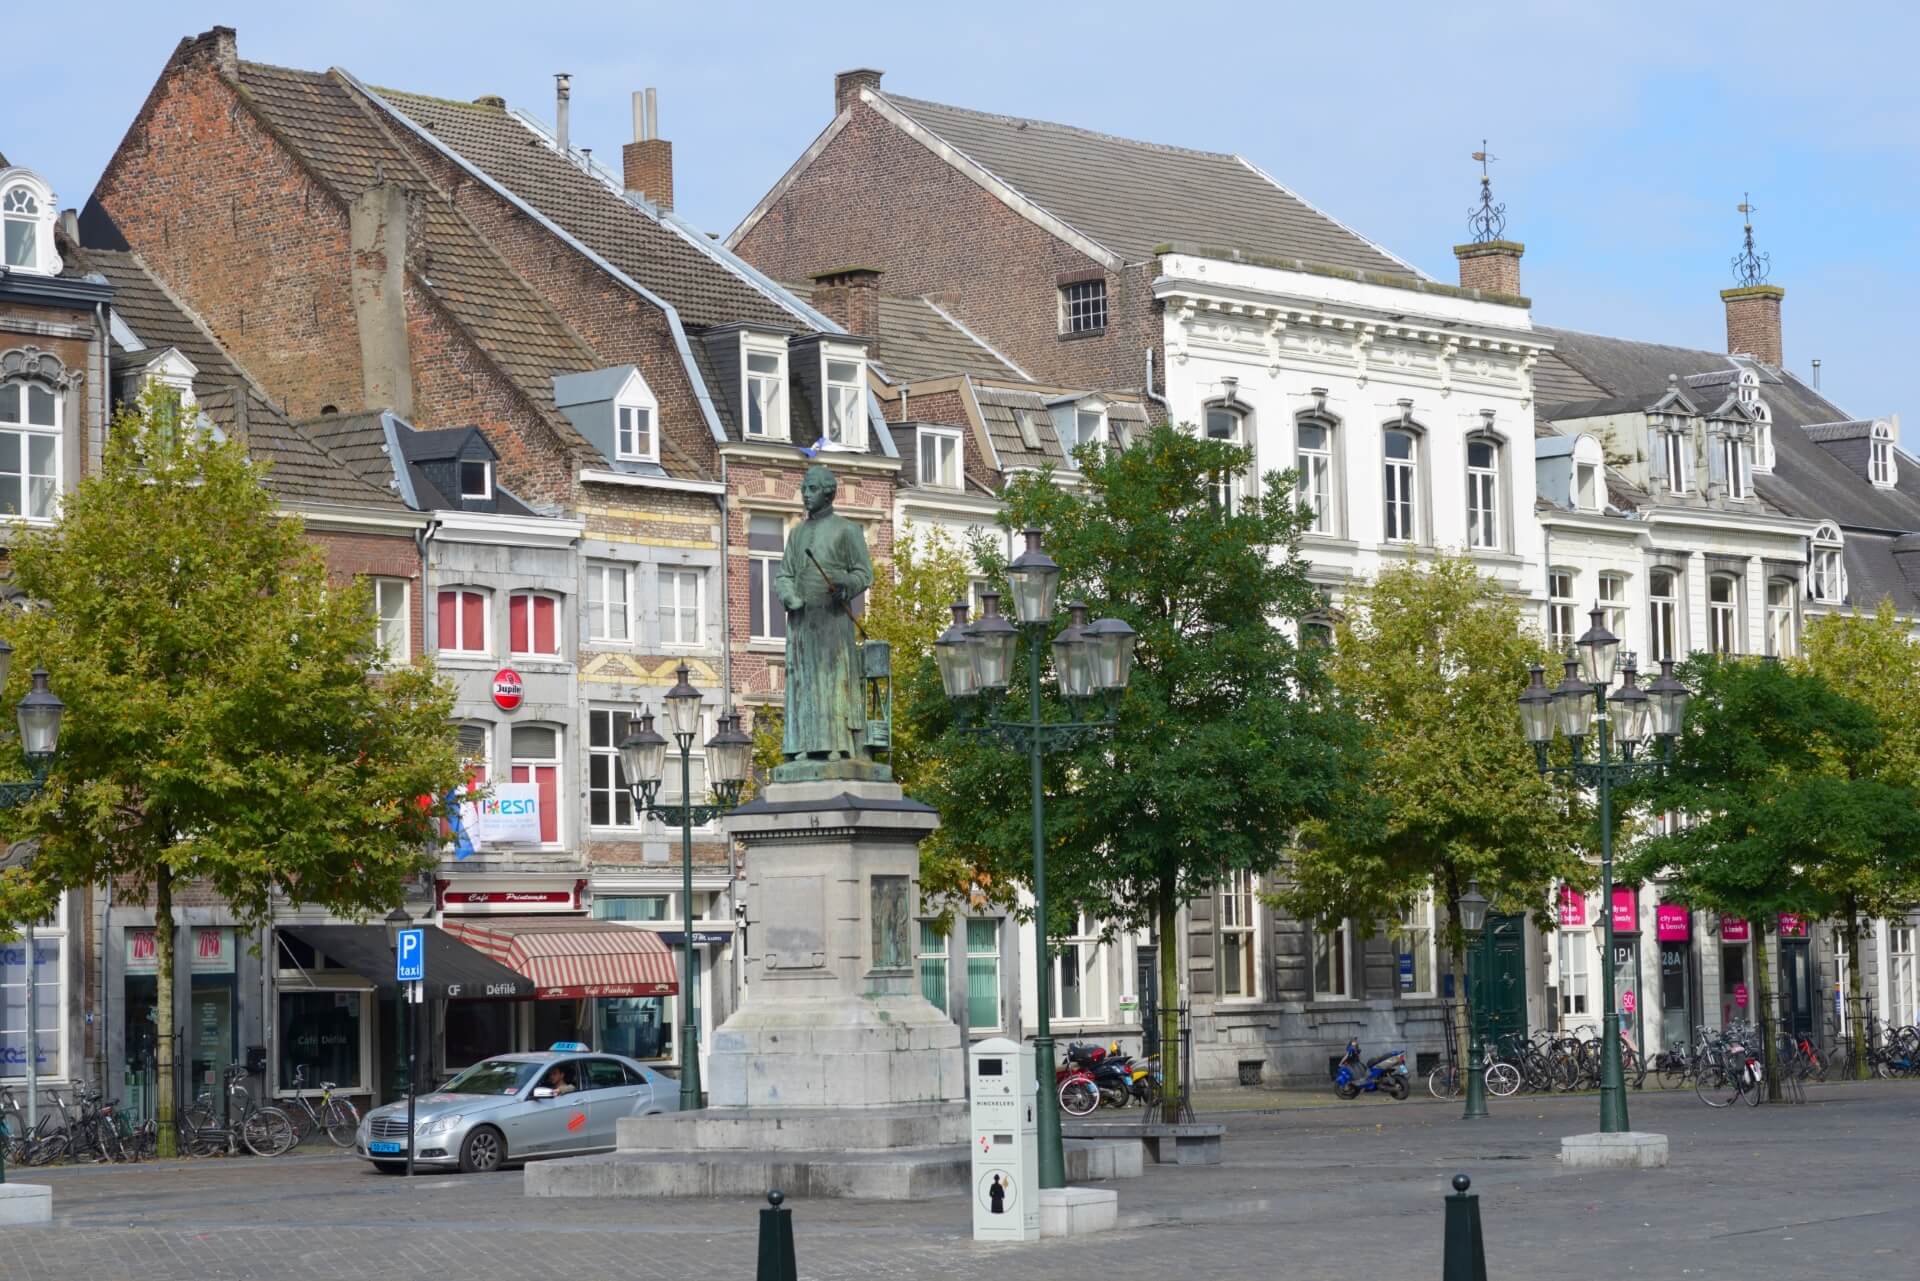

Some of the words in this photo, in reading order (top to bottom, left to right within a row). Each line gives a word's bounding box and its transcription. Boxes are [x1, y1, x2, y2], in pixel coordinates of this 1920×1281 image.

[501, 799, 535, 815] esn
[403, 934, 417, 959] P
[1662, 951, 1681, 966] 28A
[400, 965, 420, 976] taxi
[486, 982, 517, 995] Défilé
